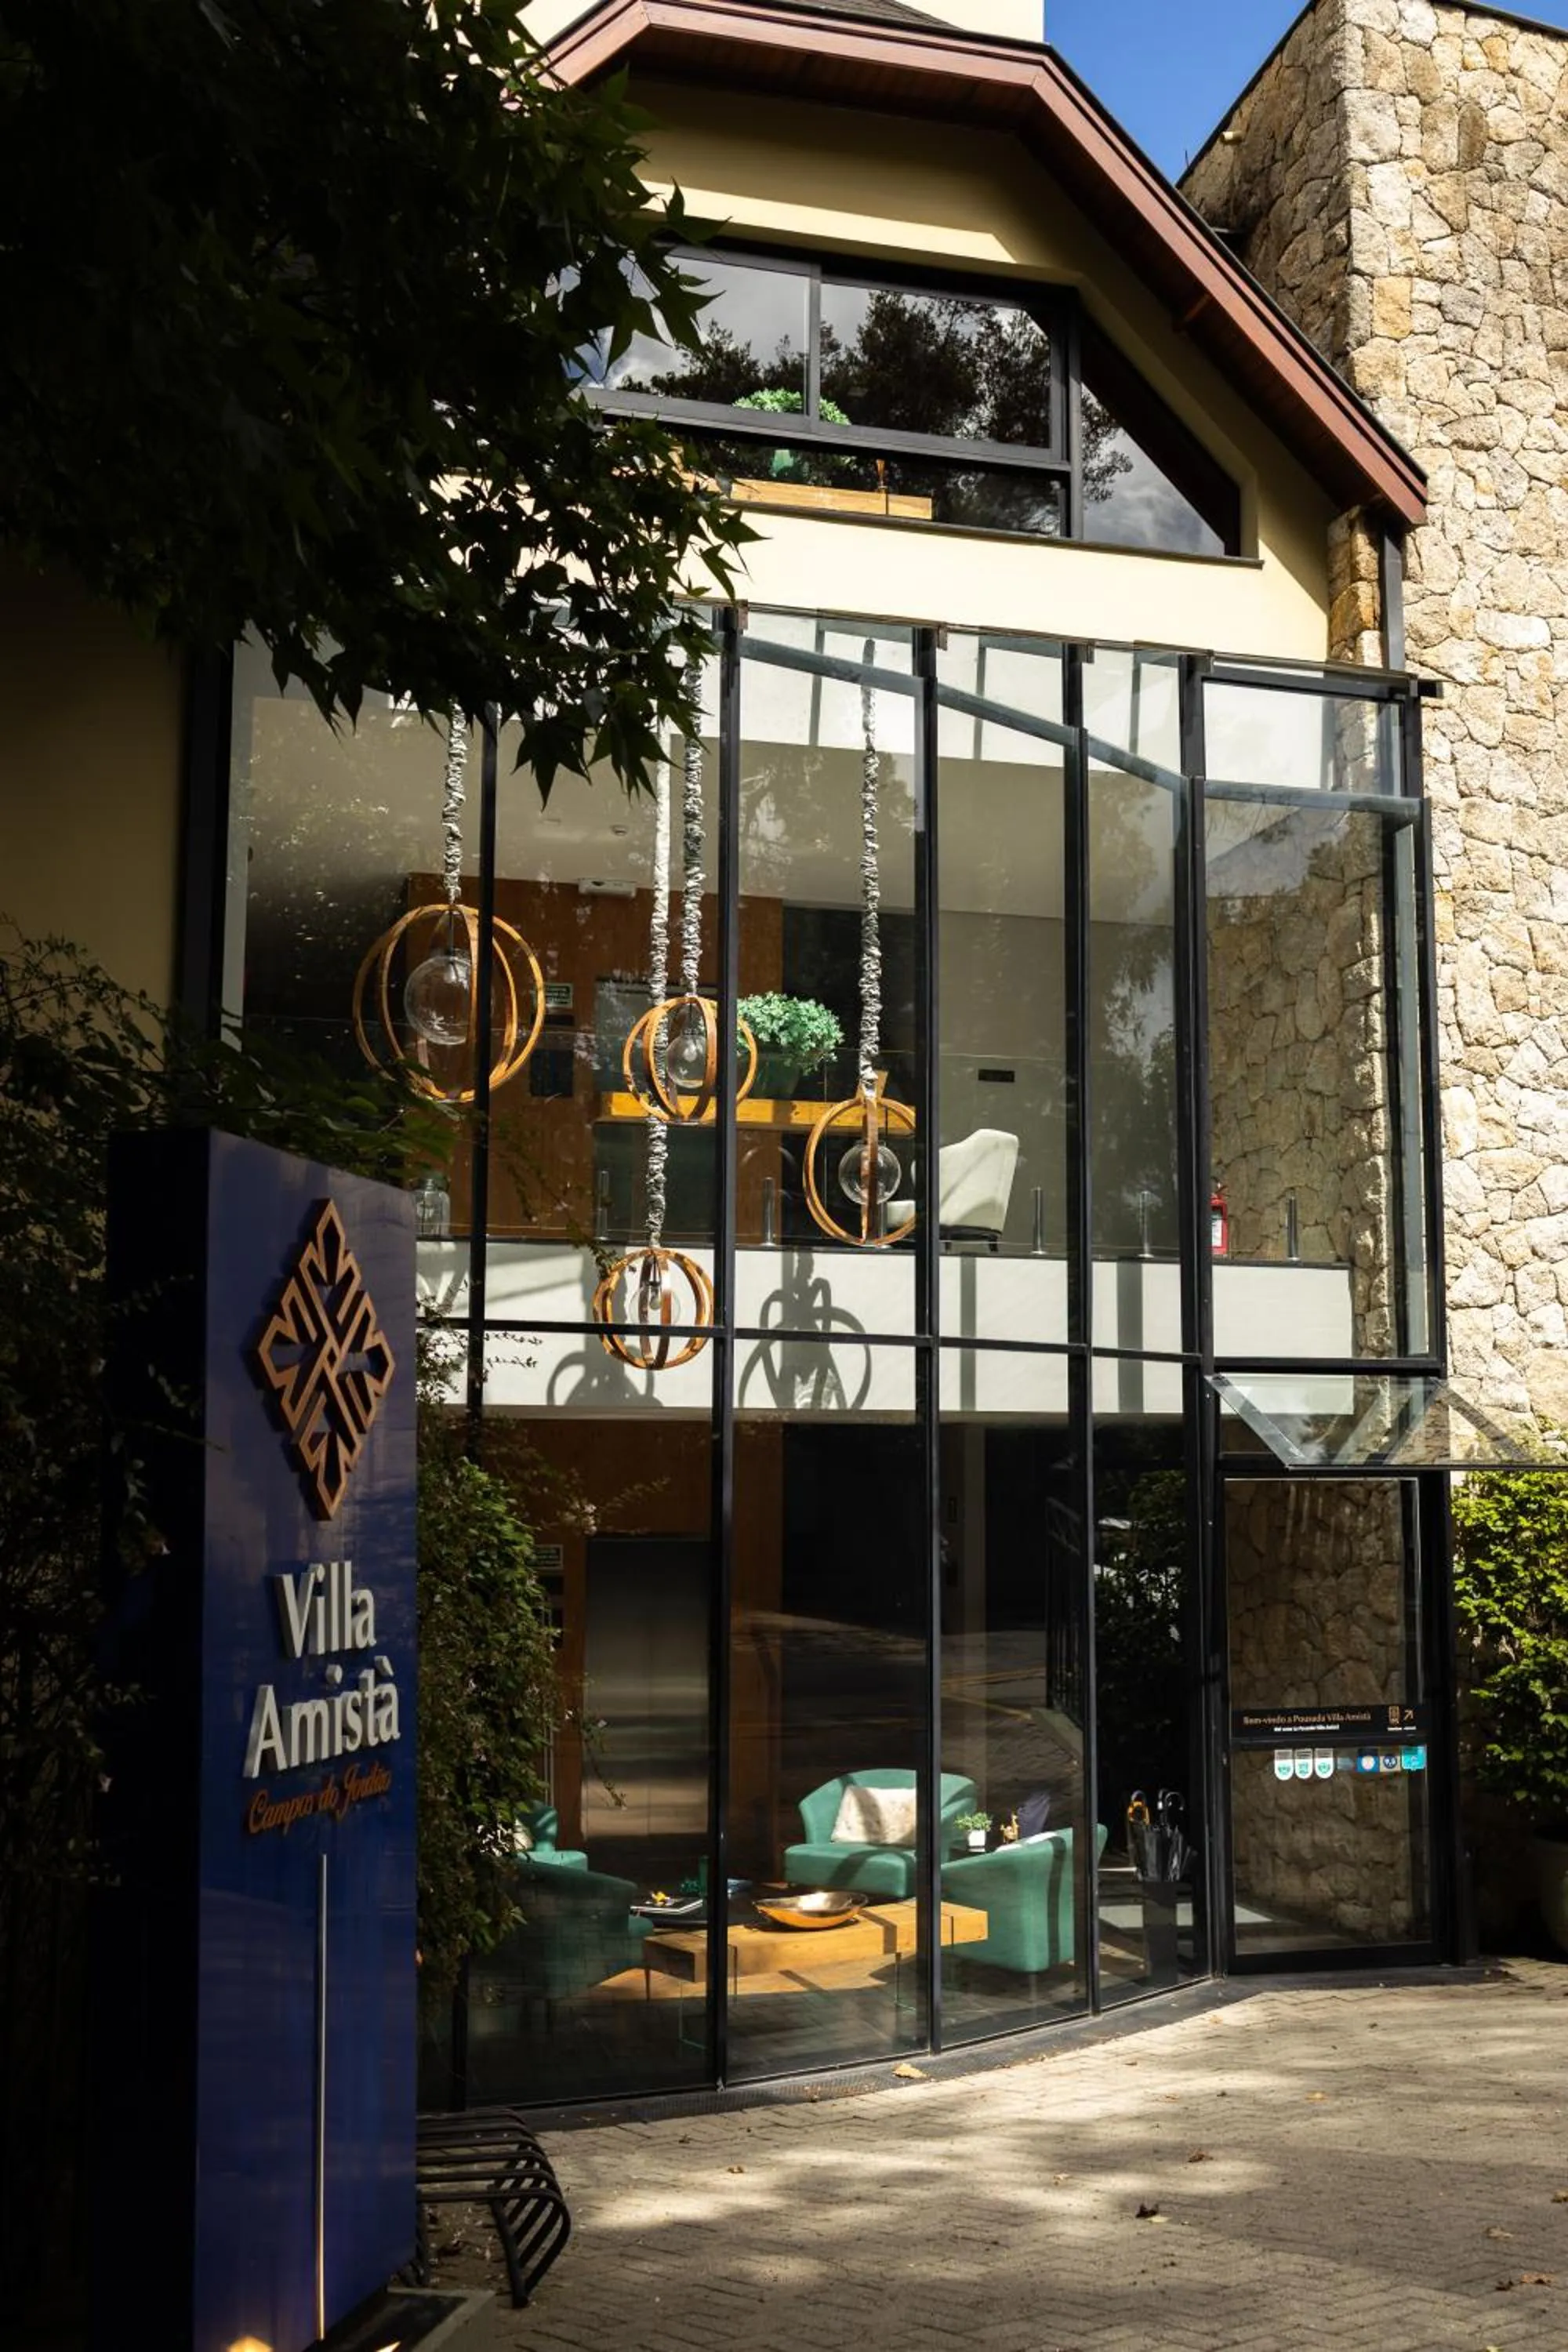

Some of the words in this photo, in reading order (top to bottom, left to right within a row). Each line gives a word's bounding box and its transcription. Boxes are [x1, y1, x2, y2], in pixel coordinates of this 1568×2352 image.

[276, 1560, 376, 1658] Villa
[242, 1655, 401, 1778] Amistà
[249, 1788, 314, 1835] Campos
[318, 1773, 339, 1810] do
